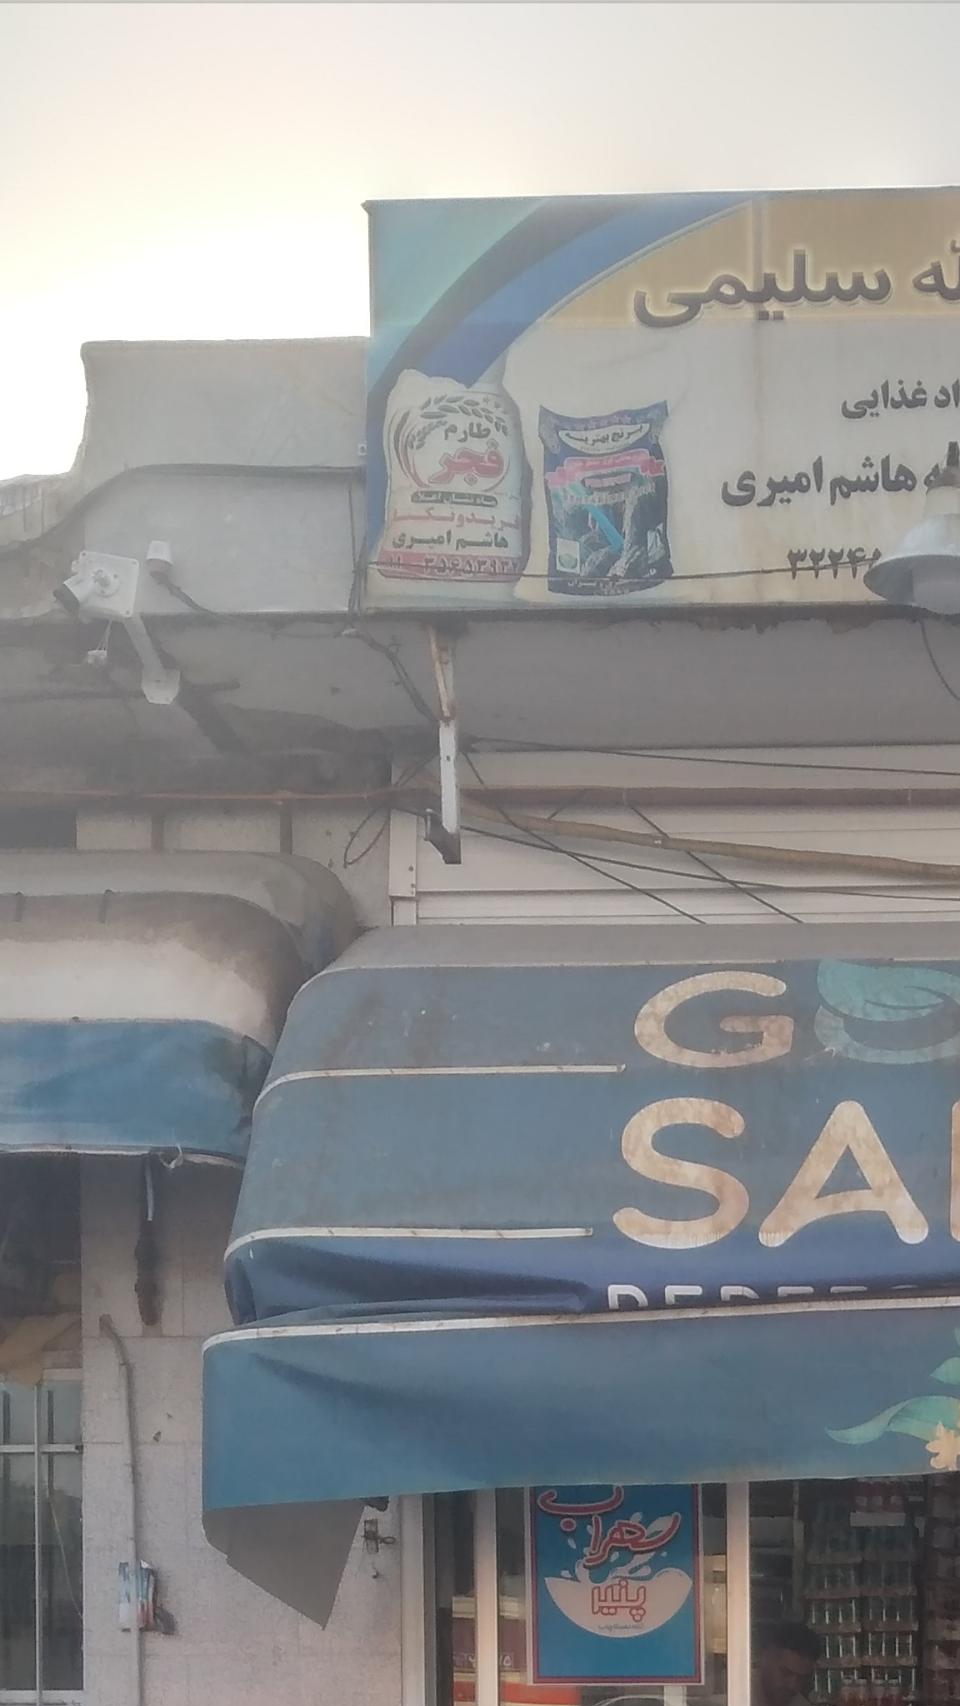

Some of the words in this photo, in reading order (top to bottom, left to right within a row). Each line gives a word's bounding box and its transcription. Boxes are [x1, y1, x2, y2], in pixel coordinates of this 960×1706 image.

[632, 248, 892, 329] سلیمی
[840, 378, 928, 420] غذایی
[443, 421, 491, 443] طارم
[427, 438, 505, 486] فجر
[720, 454, 824, 506] امیری
[829, 454, 918, 505] هاشم
[391, 529, 452, 551] امیری
[455, 531, 510, 551] هاشم
[591, 1578, 647, 1622] پنیر
